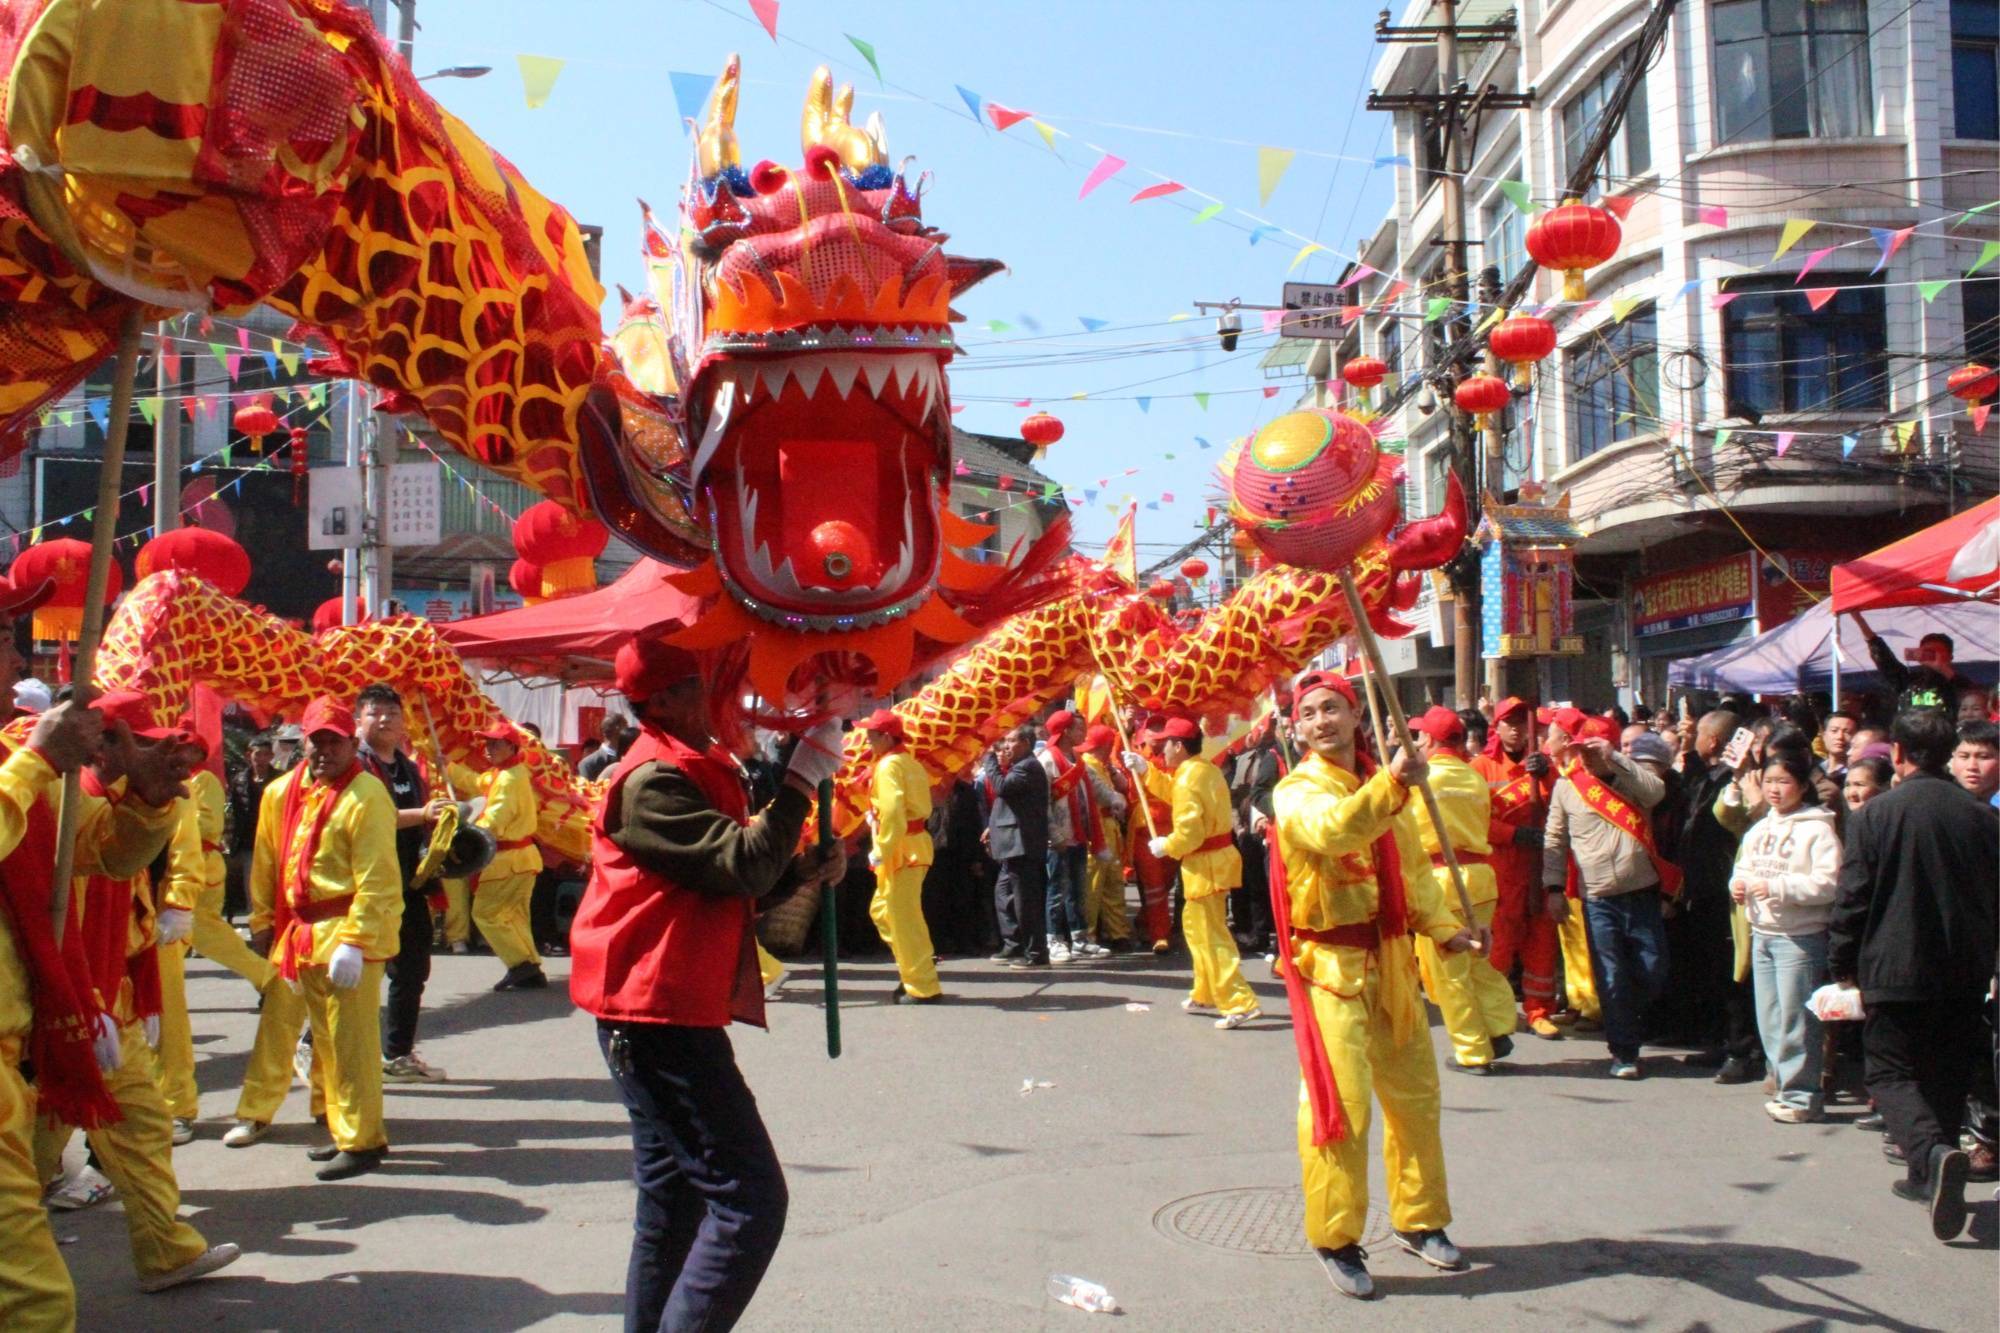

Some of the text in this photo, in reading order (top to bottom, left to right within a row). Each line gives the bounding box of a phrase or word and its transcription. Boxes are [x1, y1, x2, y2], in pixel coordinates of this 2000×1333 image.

[1302, 291, 1345, 306] 禁止停车
[1752, 833, 1796, 858] ABC
